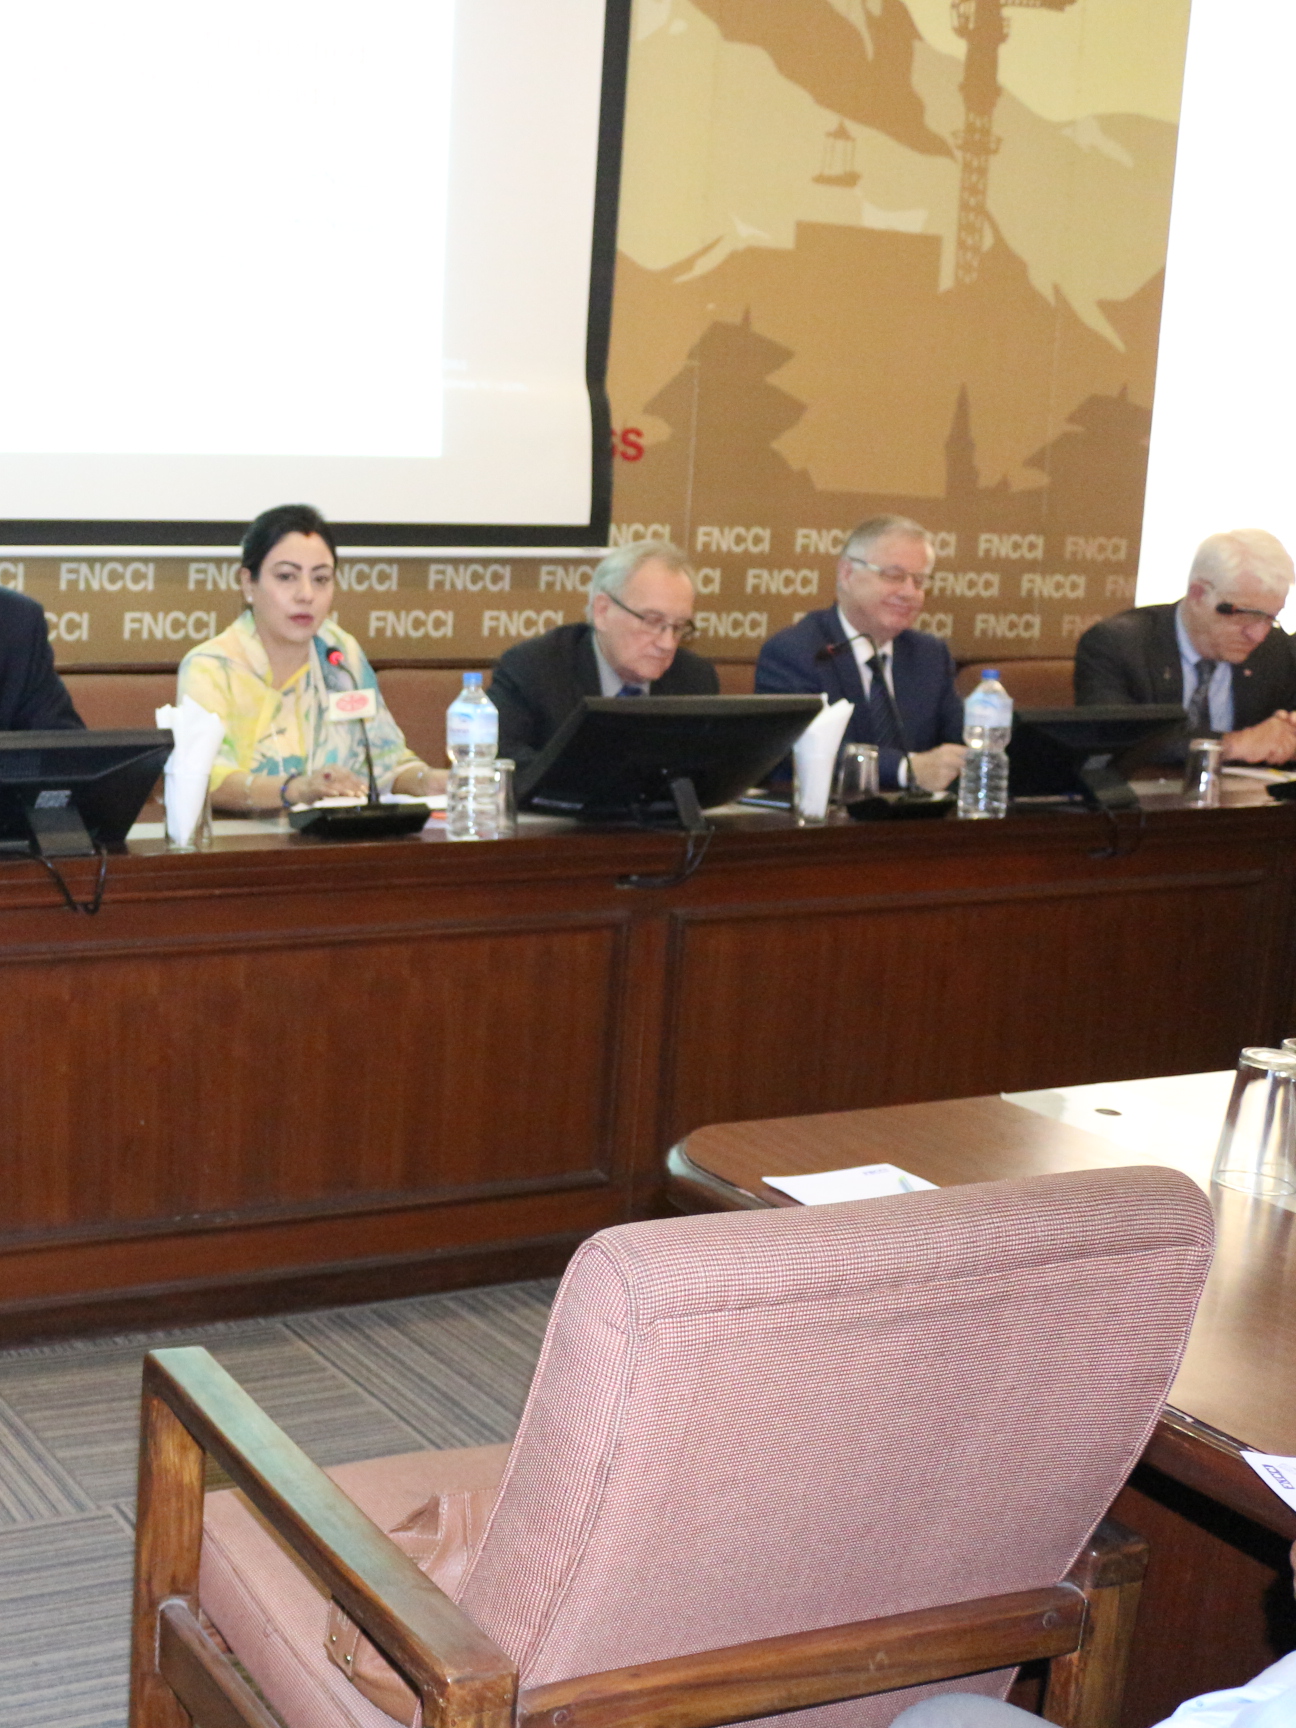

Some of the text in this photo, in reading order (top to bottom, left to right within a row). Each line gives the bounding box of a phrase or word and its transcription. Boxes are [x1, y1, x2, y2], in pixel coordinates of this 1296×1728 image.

[696, 526, 771, 553] FNCCI
[795, 528, 853, 555] FNC
[977, 533, 1044, 560] FNCCI
[59, 562, 155, 592] FNCCI
[428, 564, 511, 592] FNCCI
[746, 567, 819, 595] FNCCI
[932, 571, 1001, 598] FNCCI
[1020, 573, 1086, 599] FNCCI
[123, 611, 216, 641] FNCCI
[368, 610, 453, 638] FNCCI
[695, 611, 768, 638] FNCCI
[974, 613, 1041, 639] FNCCI
